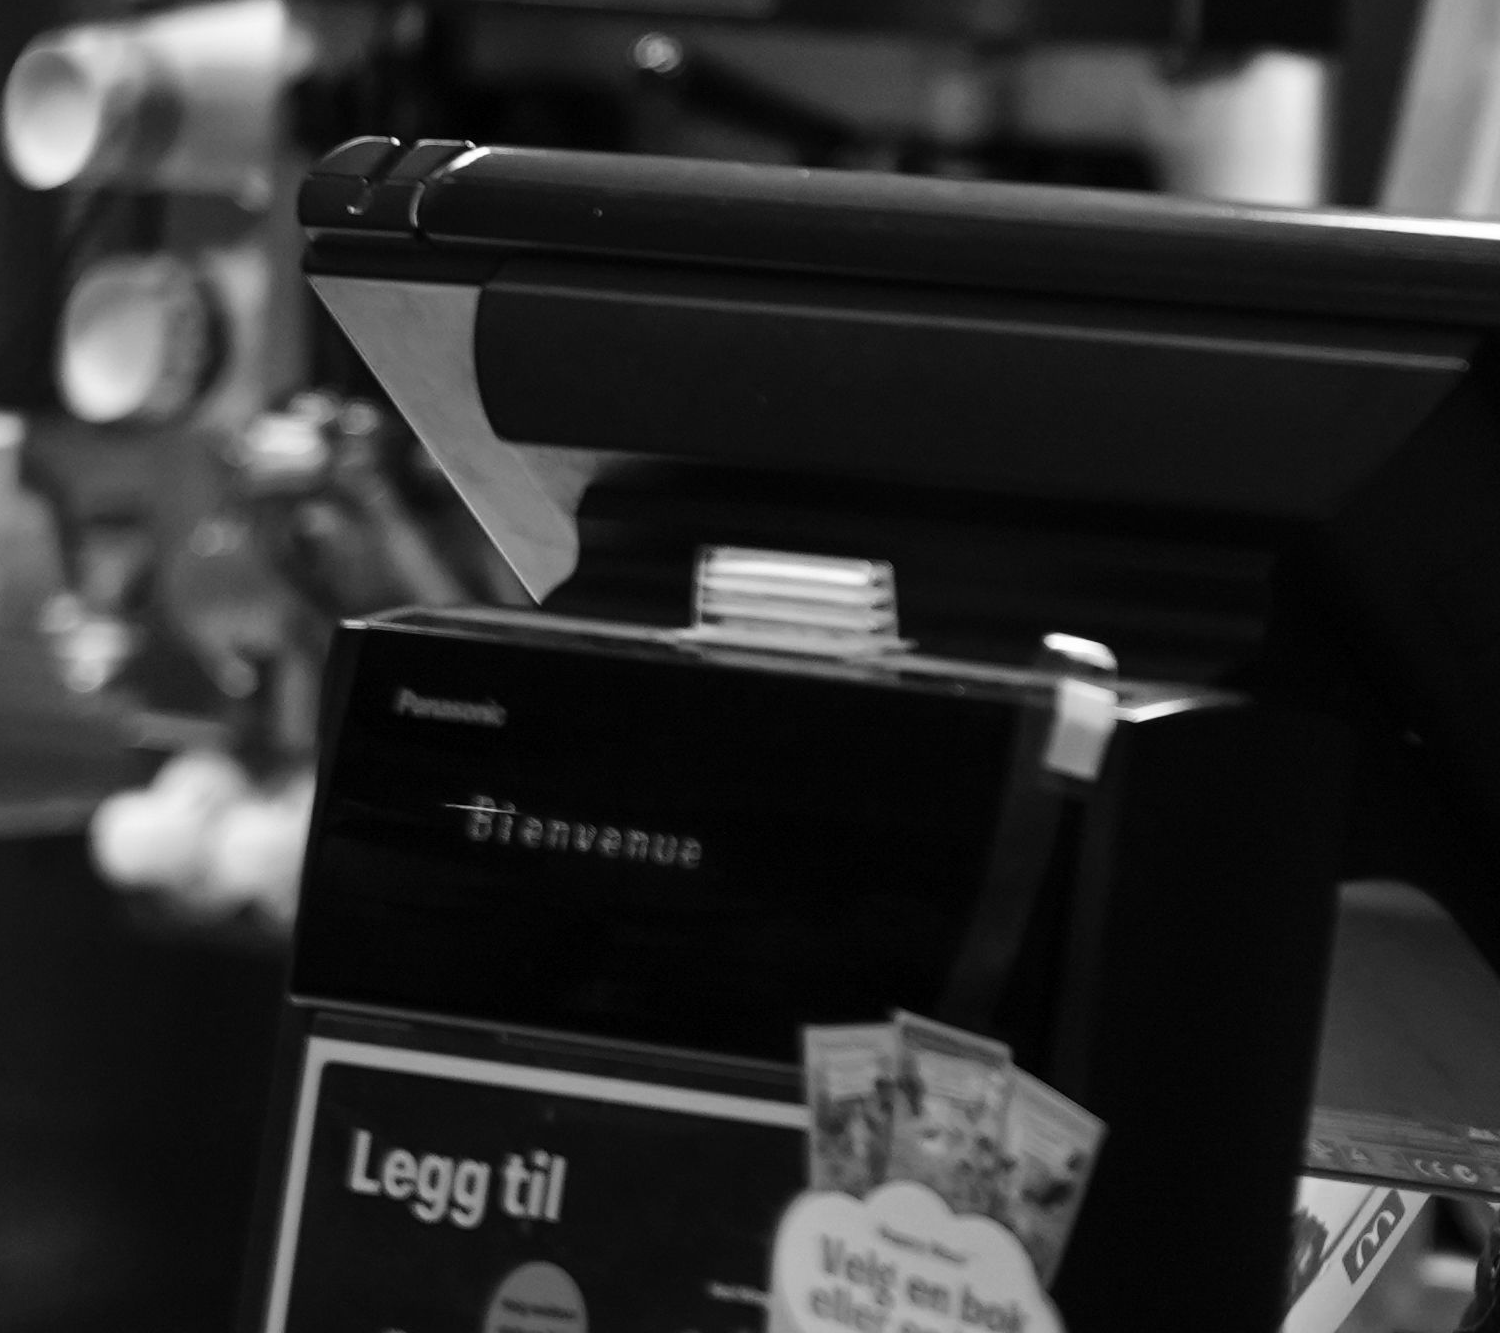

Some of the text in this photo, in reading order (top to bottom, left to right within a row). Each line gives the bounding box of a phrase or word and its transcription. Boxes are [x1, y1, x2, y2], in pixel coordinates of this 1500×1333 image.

[469, 795, 702, 869] Bienvenue
[348, 1128, 567, 1229] Legg til
